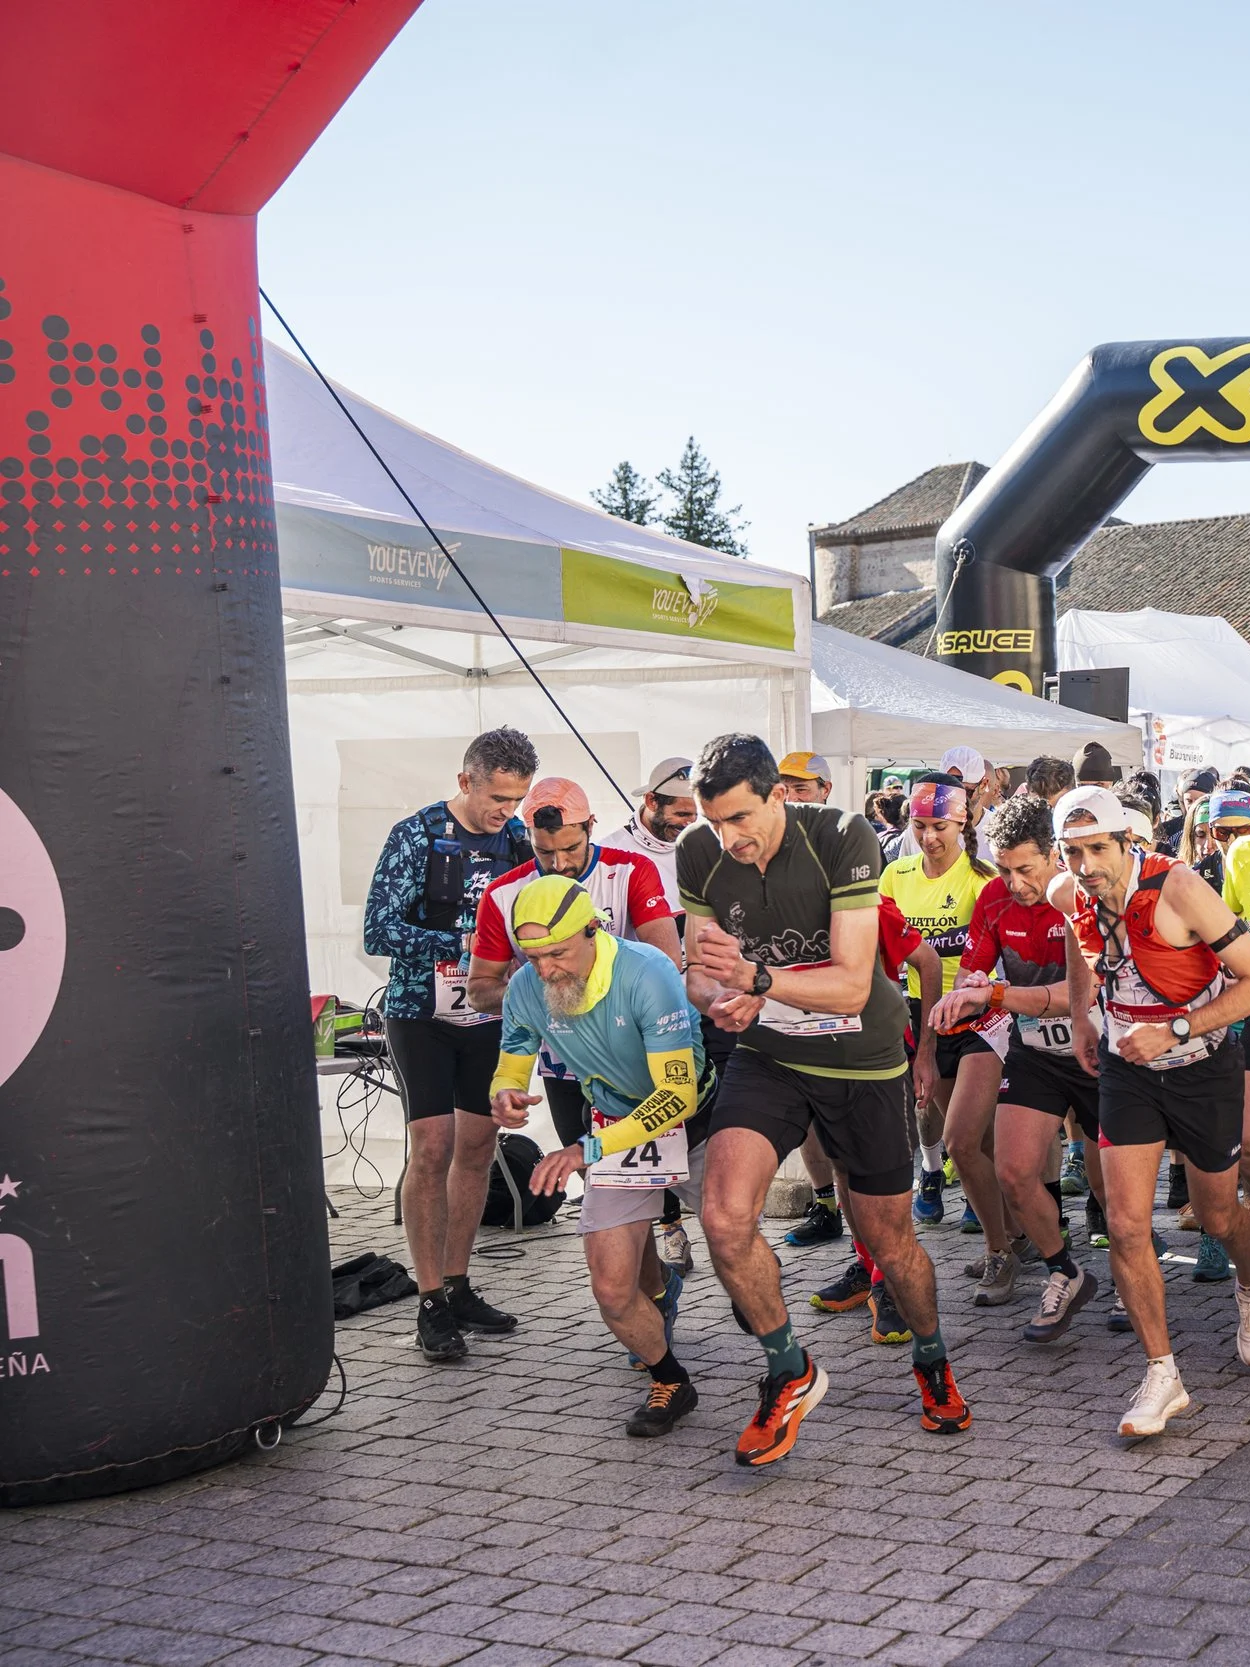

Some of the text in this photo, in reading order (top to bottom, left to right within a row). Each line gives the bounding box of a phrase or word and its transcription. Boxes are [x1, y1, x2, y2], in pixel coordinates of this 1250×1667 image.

[367, 544, 396, 573] YOU
[369, 575, 421, 588] SPORTS SERVICES
[652, 588, 675, 612] YOU
[905, 914, 958, 927] RIATLÓN
[1113, 1007, 1134, 1023] fmm
[1037, 1023, 1073, 1047] 10
[641, 1095, 688, 1133] TRAIL
[621, 1140, 662, 1168] 24
